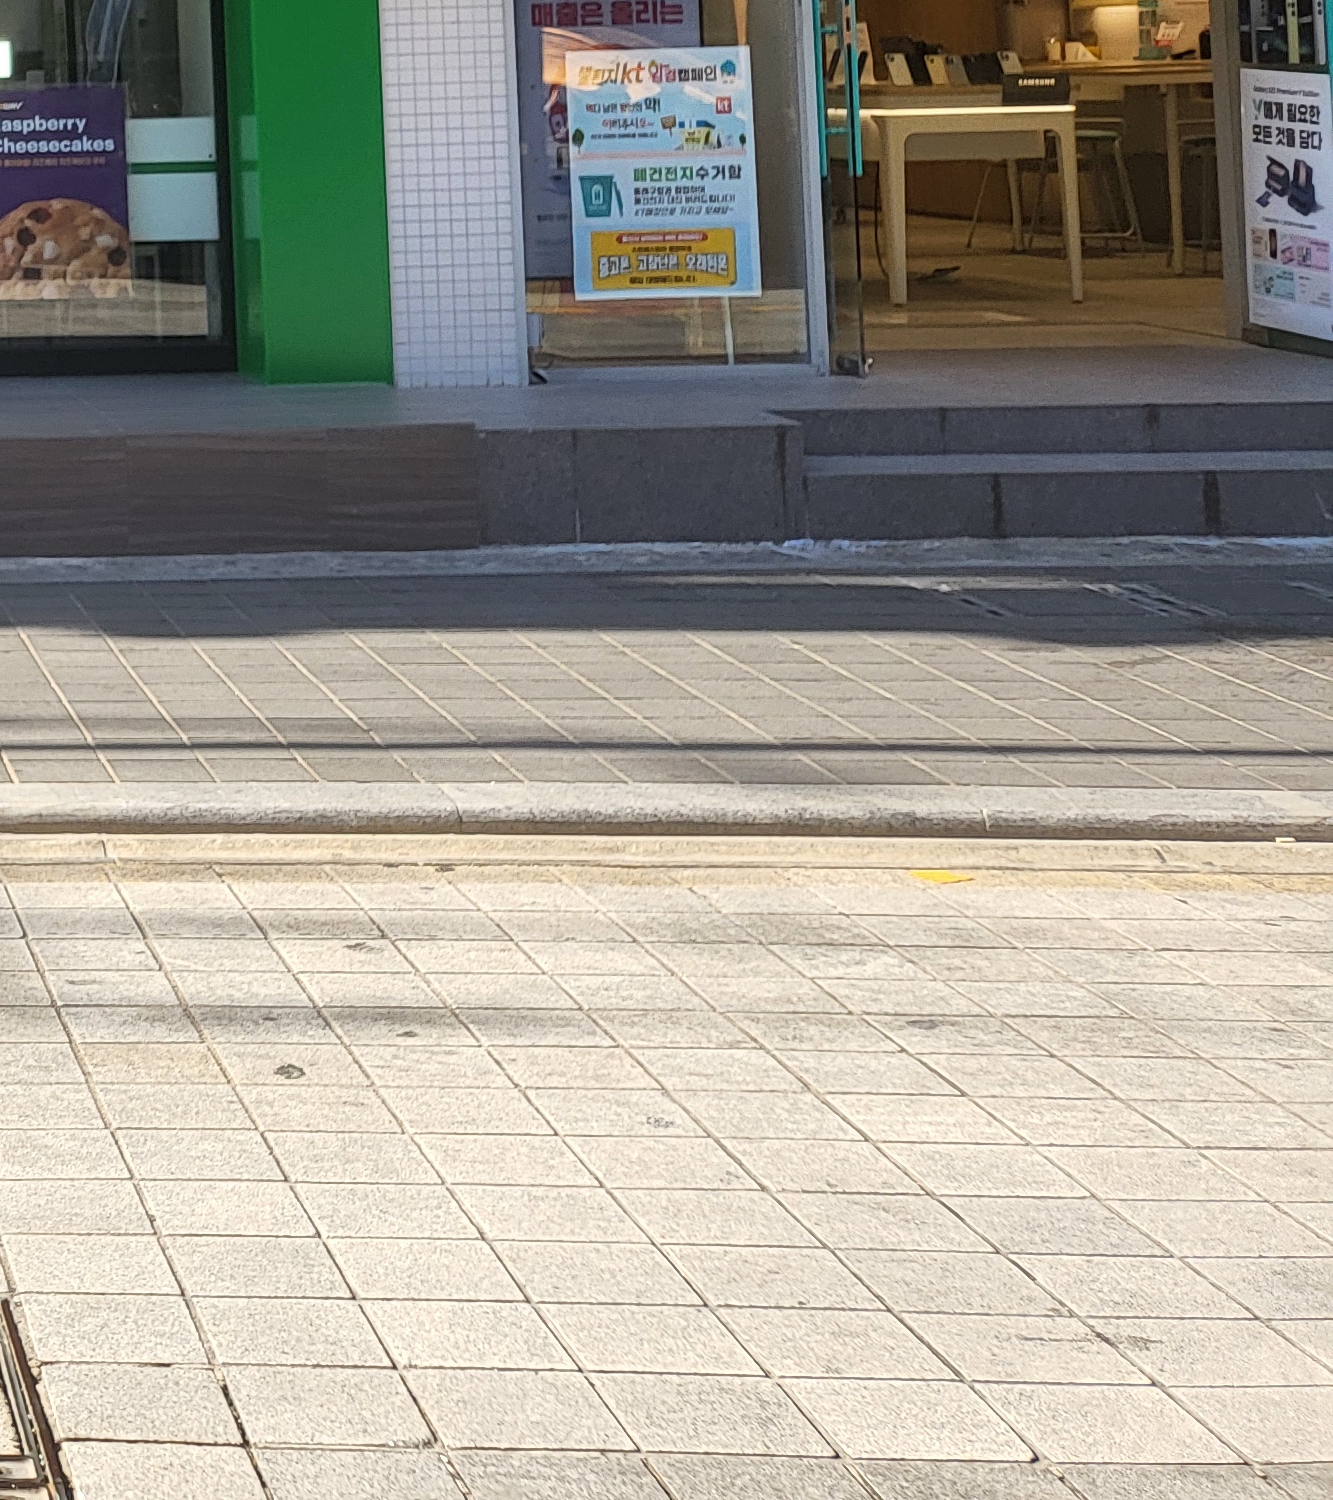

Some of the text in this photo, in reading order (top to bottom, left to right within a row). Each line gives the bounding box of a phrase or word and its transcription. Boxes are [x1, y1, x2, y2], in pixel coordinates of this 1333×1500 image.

[1287, 102, 1321, 125] 필요한
[1252, 124, 1272, 145] 모든
[1299, 129, 1323, 151] 담다
